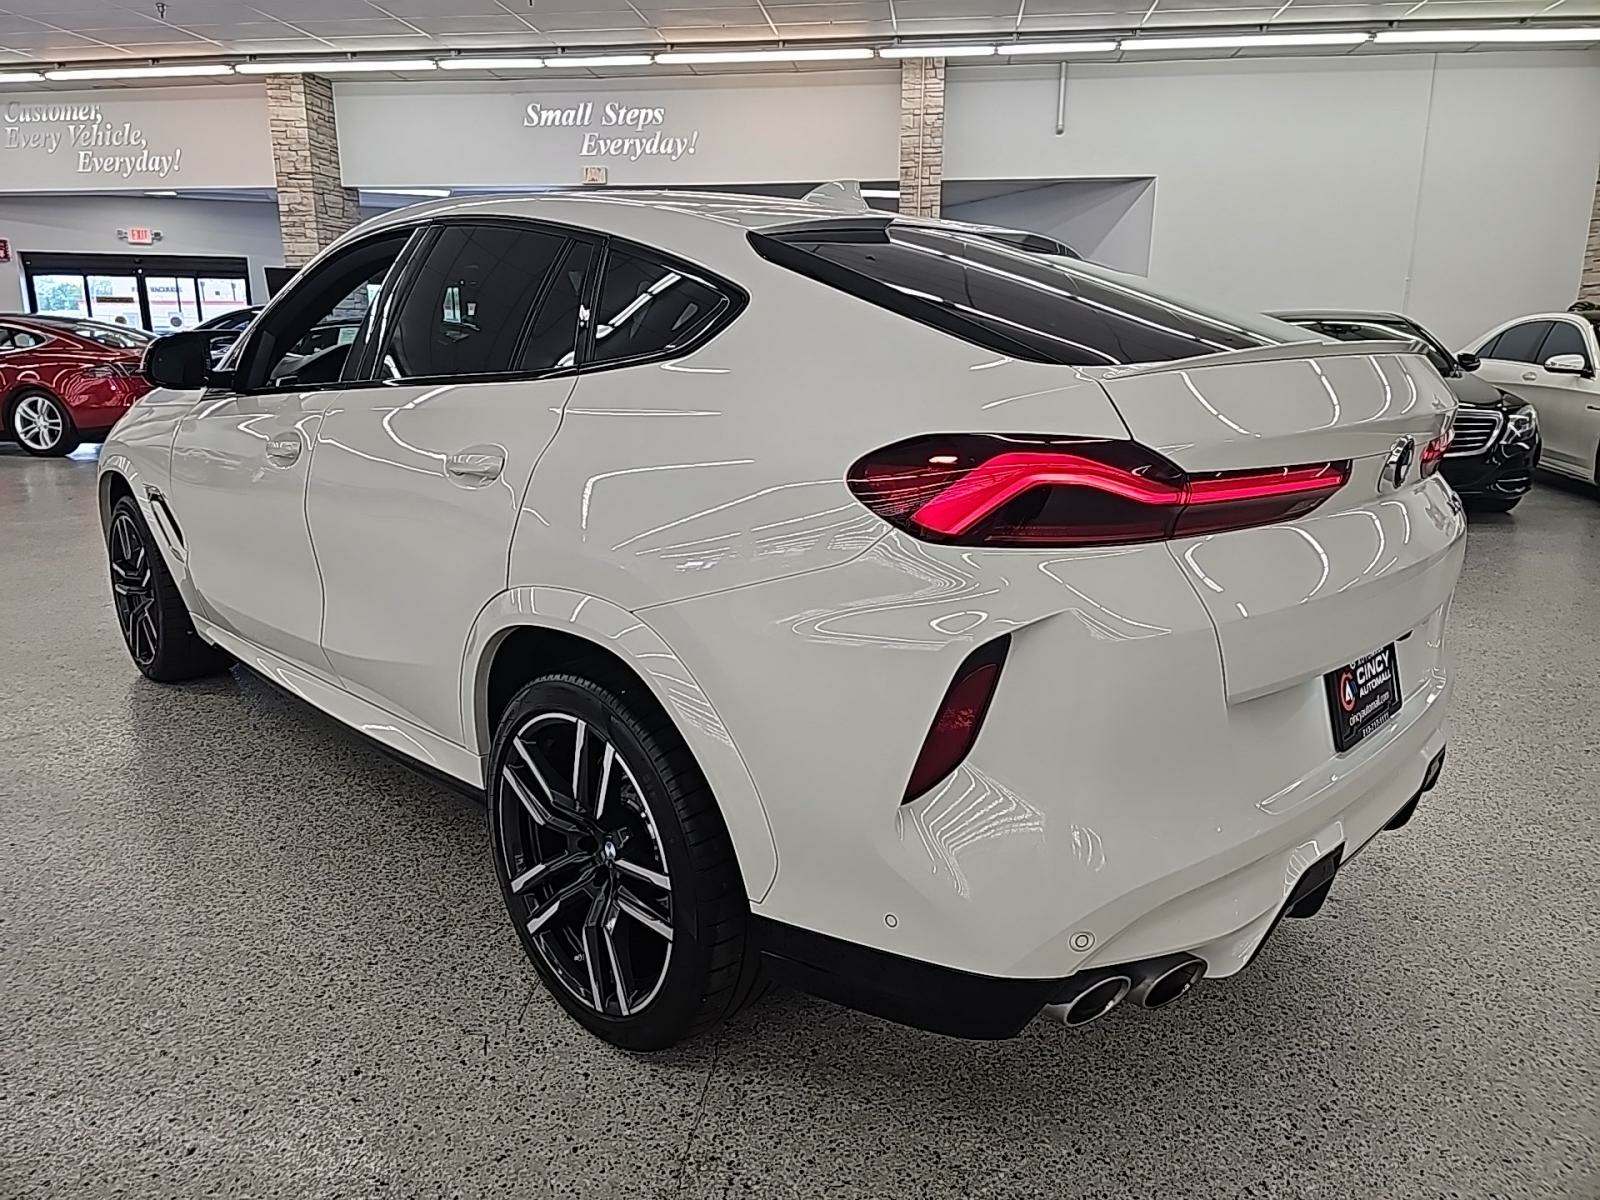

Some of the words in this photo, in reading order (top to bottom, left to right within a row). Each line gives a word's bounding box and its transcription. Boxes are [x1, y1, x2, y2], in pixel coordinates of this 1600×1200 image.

[4, 101, 103, 124] Customer,
[524, 102, 593, 127] Small
[602, 102, 665, 131] Steps
[5, 126, 62, 154] Every
[68, 122, 148, 150] Vehicle,
[580, 130, 698, 161] Everyday!
[77, 149, 182, 178] Everyday!
[131, 229, 149, 240] EXIT
[1356, 649, 1390, 685] CINCY
[1359, 669, 1392, 698] AUTOMALL
